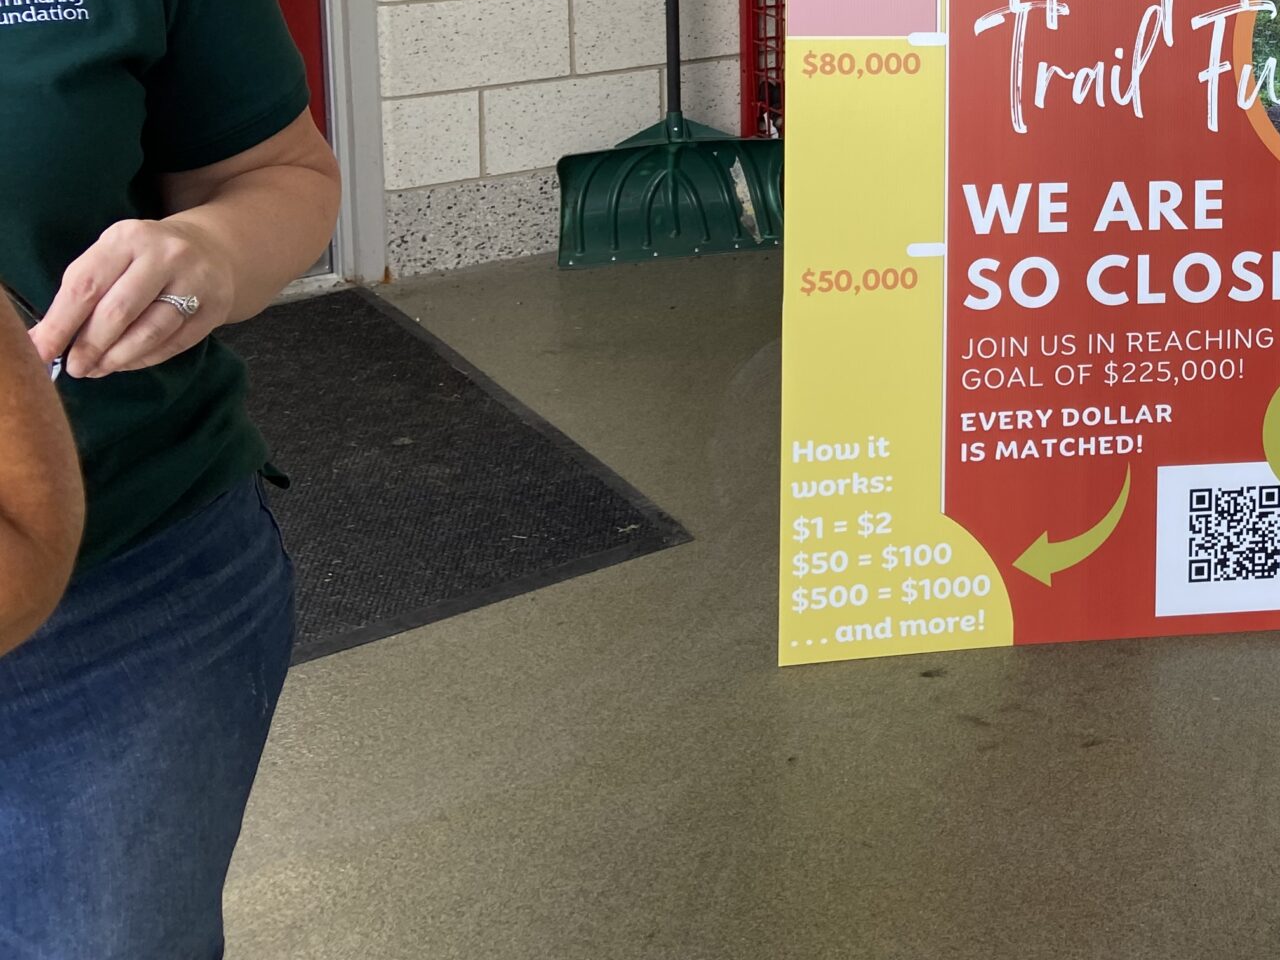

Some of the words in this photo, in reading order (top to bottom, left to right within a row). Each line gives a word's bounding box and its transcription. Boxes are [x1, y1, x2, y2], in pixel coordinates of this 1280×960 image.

[802, 50, 921, 79] $80,000
[974, 1, 1163, 134] Trail
[961, 182, 1069, 235] WE
[1093, 179, 1224, 232] ARE
[800, 267, 918, 296] $50,000
[963, 256, 1060, 311] SO
[961, 335, 1029, 361] JOIN
[1040, 333, 1076, 357] US
[1088, 332, 1116, 355] IN
[1126, 327, 1274, 354] REACHING
[961, 366, 1044, 390] GOAL
[1053, 363, 1093, 387] OF
[1103, 358, 1245, 388] $225,000!
[960, 408, 1054, 432] EVERY
[1061, 404, 1173, 428] DOLLAR
[792, 439, 860, 463] How
[867, 435, 890, 458] it
[960, 441, 986, 462] IS
[995, 434, 1144, 460] MATCHED!
[791, 472, 893, 498] works:
[792, 515, 824, 543] $1
[834, 520, 848, 533] =
[857, 510, 893, 538] $2
[792, 550, 849, 578] $50
[858, 553, 872, 566] =
[881, 543, 952, 571] $100
[791, 584, 868, 614] $500
[878, 587, 892, 599] =
[901, 575, 991, 605] $1000
[834, 616, 893, 643] and
[899, 609, 985, 638] more!
